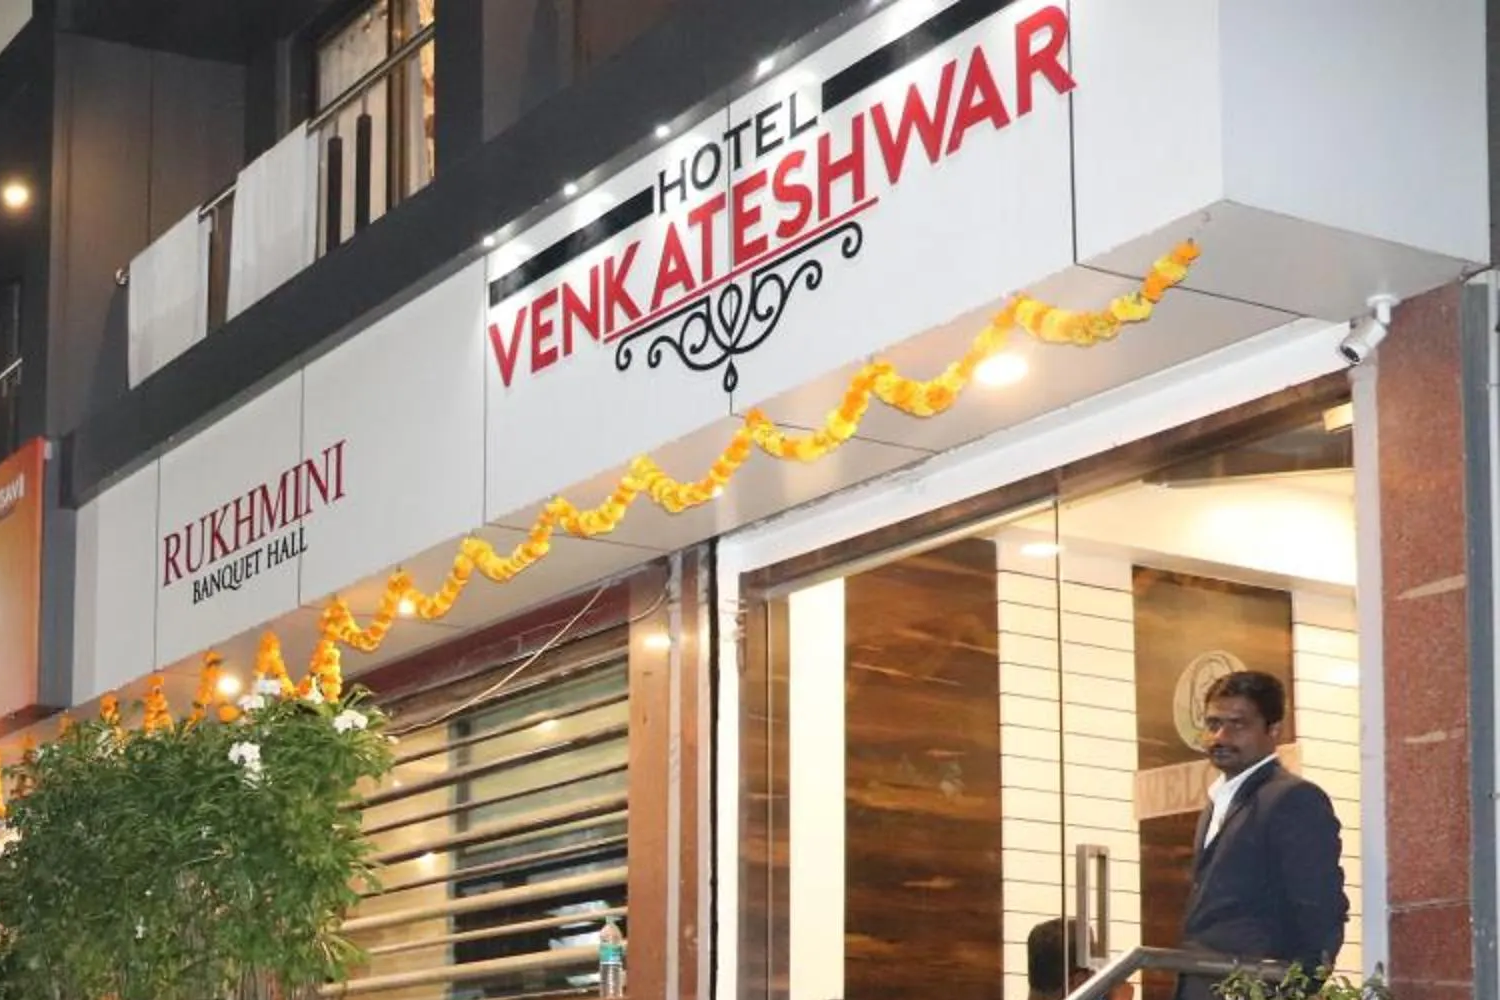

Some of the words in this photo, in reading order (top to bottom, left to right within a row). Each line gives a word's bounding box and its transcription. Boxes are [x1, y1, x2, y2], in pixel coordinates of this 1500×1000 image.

[488, 5, 1077, 388] VENKATESHWAR
[658, 91, 818, 215] HOTEL
[163, 439, 347, 587] RUKHMINI
[192, 548, 263, 604] BANQUET
[267, 527, 308, 569] HALL
